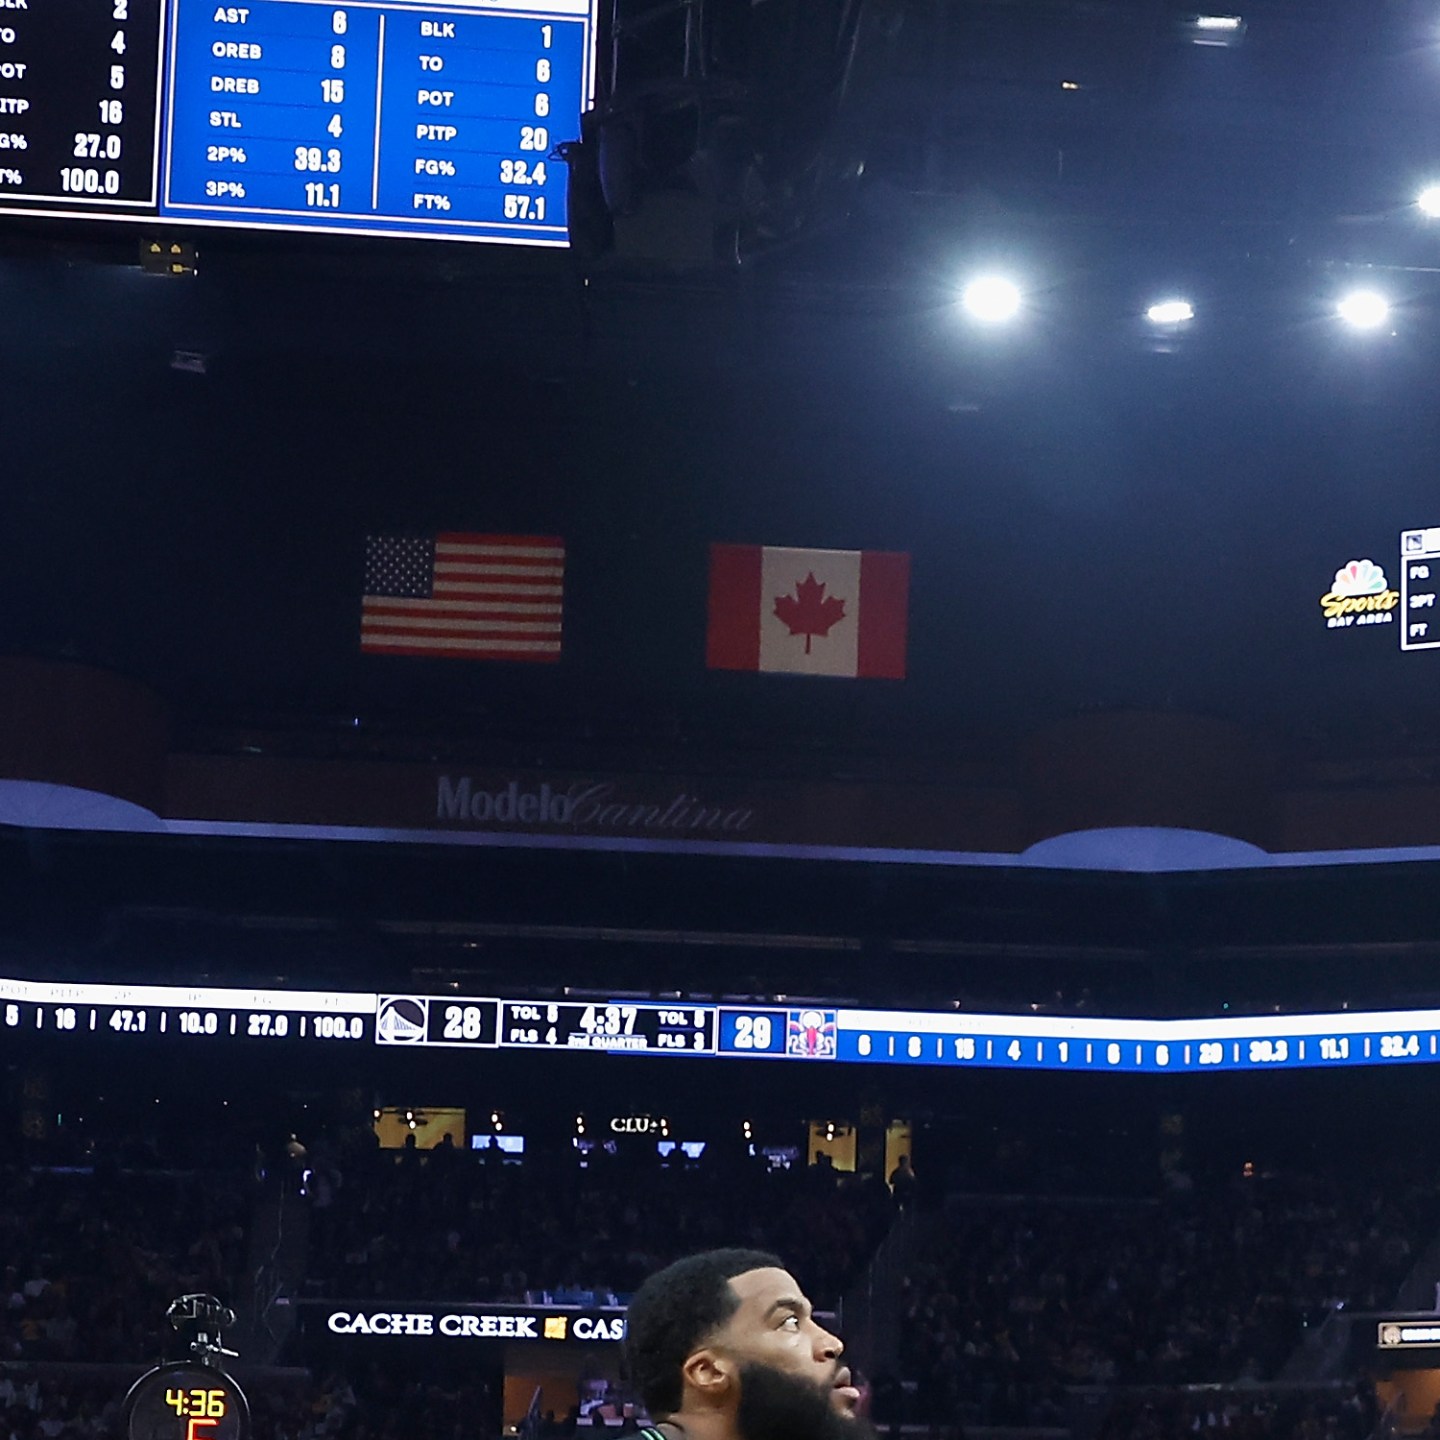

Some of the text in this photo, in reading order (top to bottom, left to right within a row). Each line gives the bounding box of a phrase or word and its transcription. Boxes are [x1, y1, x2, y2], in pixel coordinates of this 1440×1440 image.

[0, 0, 128, 20] LK 2
[213, 7, 348, 35] AST 6
[0, 27, 126, 55] O 4
[420, 21, 552, 48] BLK 1
[212, 41, 346, 69] OREB 8
[419, 55, 551, 83] TO 6
[0, 63, 125, 90] OT 5
[210, 76, 344, 104] DREB 15
[99, 99, 123, 124] 16
[417, 90, 550, 117] POT 6
[209, 111, 343, 138] STL 4
[416, 124, 548, 151] PITP 20
[73, 132, 122, 160] 27.0
[207, 145, 341, 173] 2P% 39.3
[60, 167, 120, 194] 100.0
[414, 159, 547, 186] FG% 32.4
[205, 180, 340, 208] 3P% 11.1
[413, 193, 546, 221] FT% 57.1
[1320, 589, 1400, 619] Sports
[436, 775, 573, 824] Modelo
[109, 1009, 147, 1033] 47.1
[443, 1005, 481, 1040] 28
[511, 1005, 541, 1021] TOL
[579, 1005, 638, 1035] 4:37
[658, 1011, 688, 1026] TOL
[545, 1026, 557, 1046] 4
[733, 1016, 772, 1049] 29
[1007, 1040, 1021, 1061] 4
[1058, 1041, 1069, 1063] 1
[1320, 1037, 1349, 1060] 11.1
[327, 1311, 434, 1335] CACHE
[439, 1315, 537, 1338] CREEK
[165, 1388, 226, 1418] 4:36
